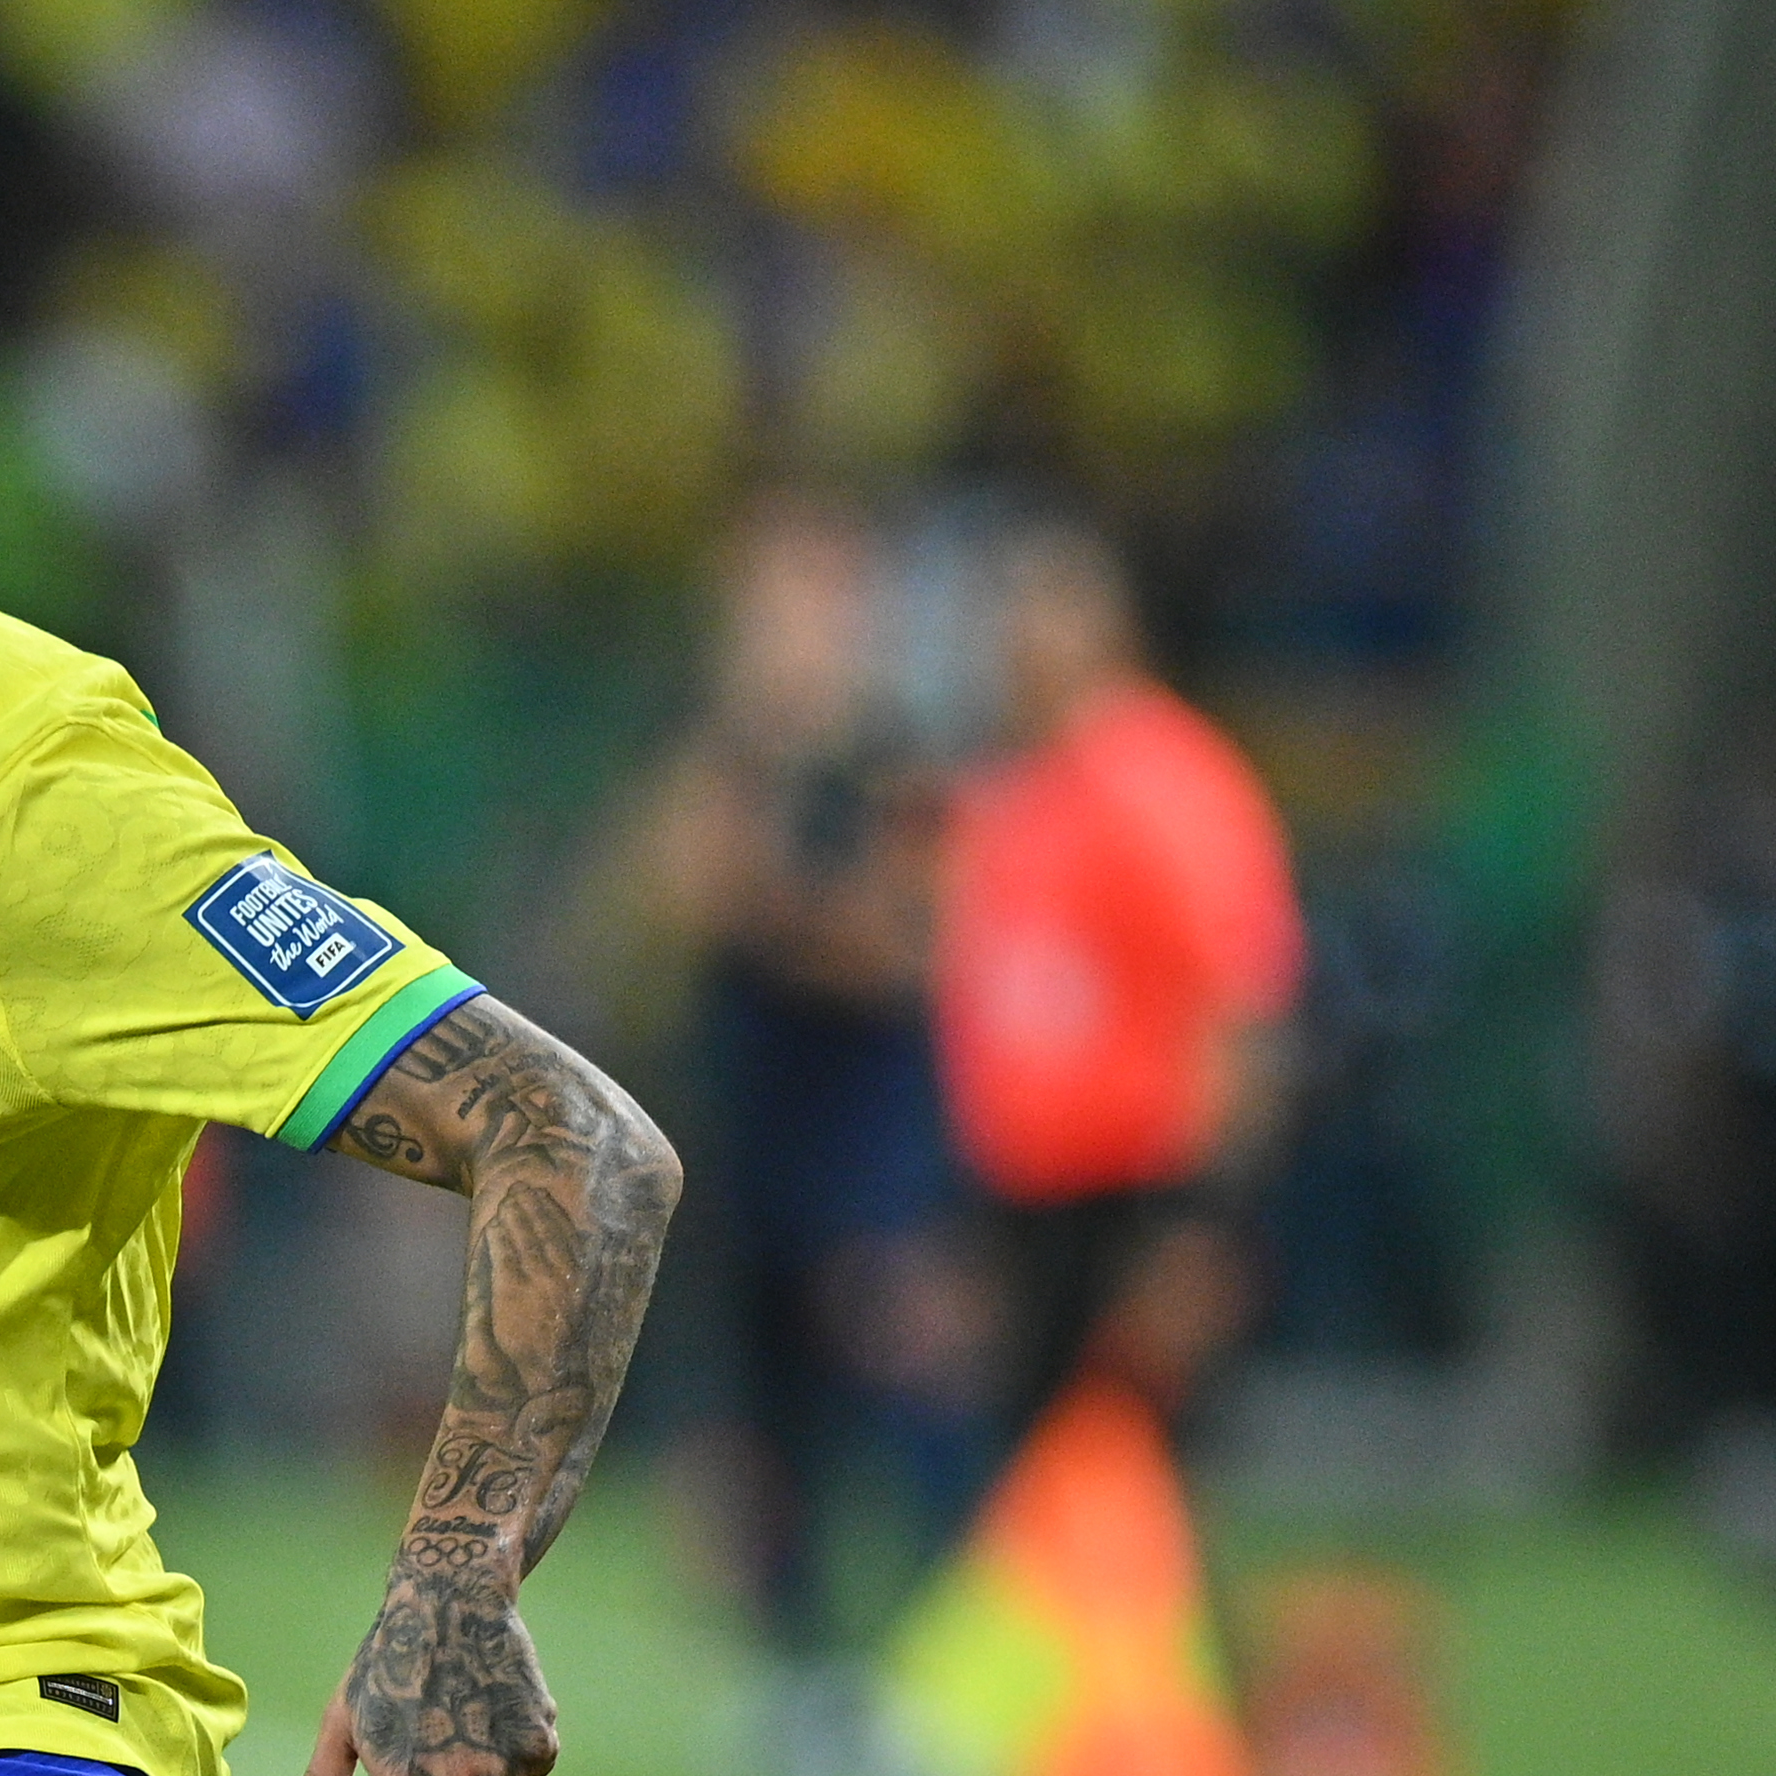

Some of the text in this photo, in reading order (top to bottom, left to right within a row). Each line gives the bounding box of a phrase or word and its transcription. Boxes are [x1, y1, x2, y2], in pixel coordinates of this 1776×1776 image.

[247, 889, 319, 947] UNITES
[270, 904, 344, 972] the World
[315, 940, 346, 968] FIFA
